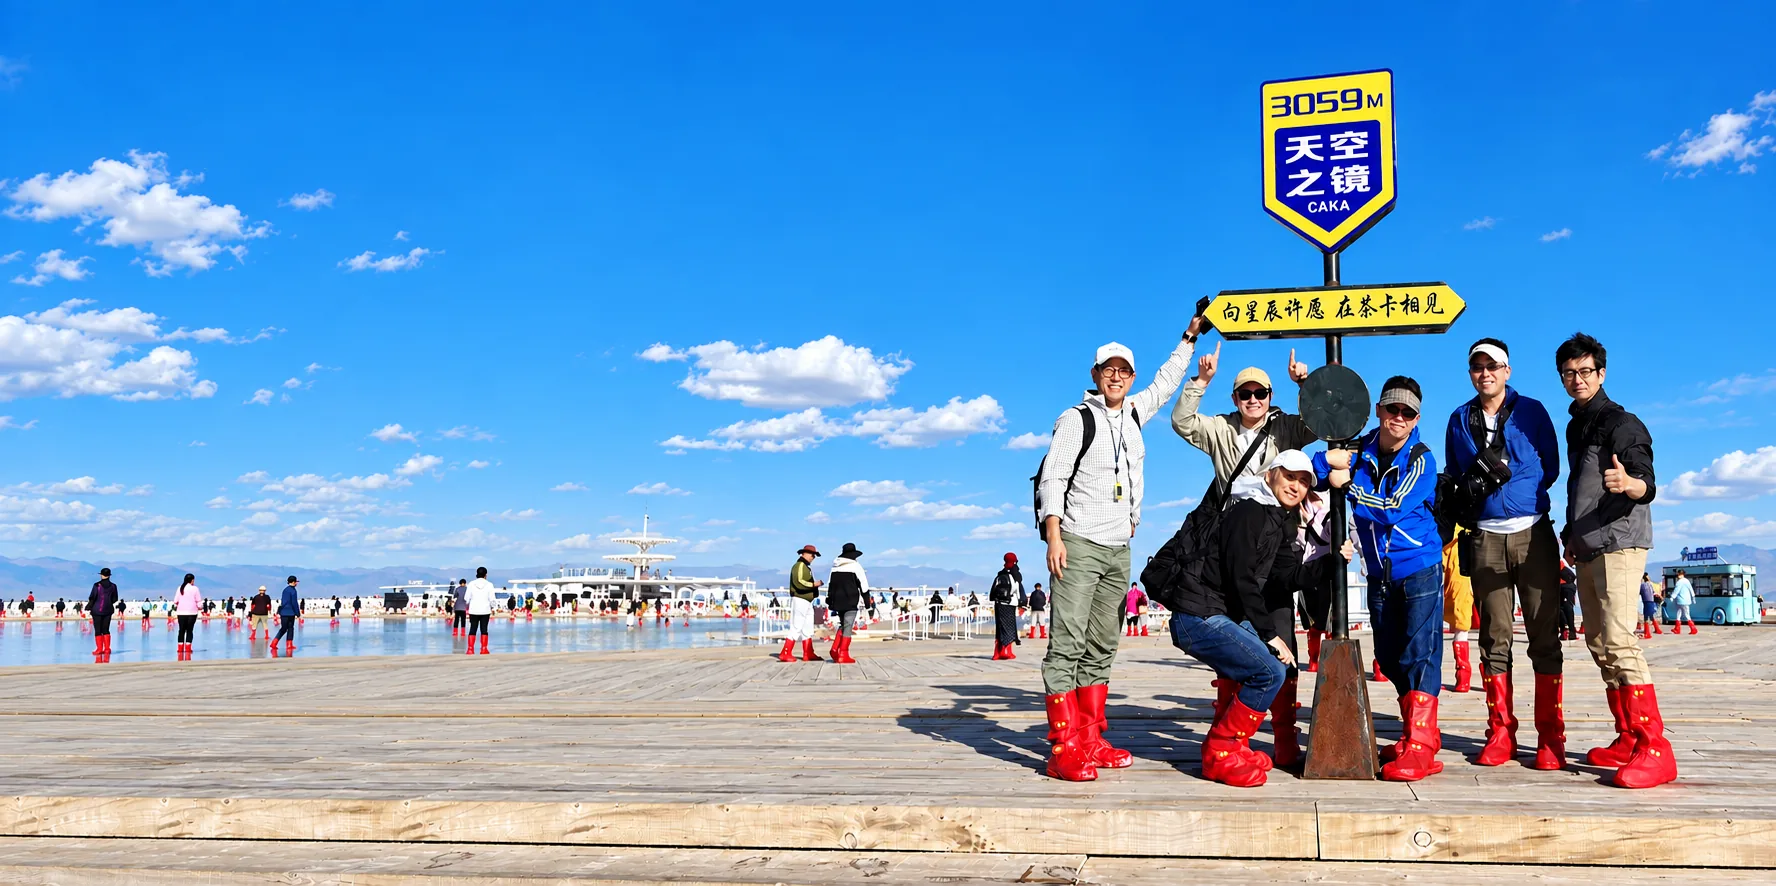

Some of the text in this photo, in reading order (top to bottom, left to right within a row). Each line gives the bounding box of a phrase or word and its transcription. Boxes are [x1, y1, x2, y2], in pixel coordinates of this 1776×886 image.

[1285, 131, 1369, 164] 天空
[1286, 164, 1371, 197] 之镜
[1307, 199, 1350, 213] CAKA
[1222, 292, 1445, 324] 向星辰许愿 在茶卡相见
